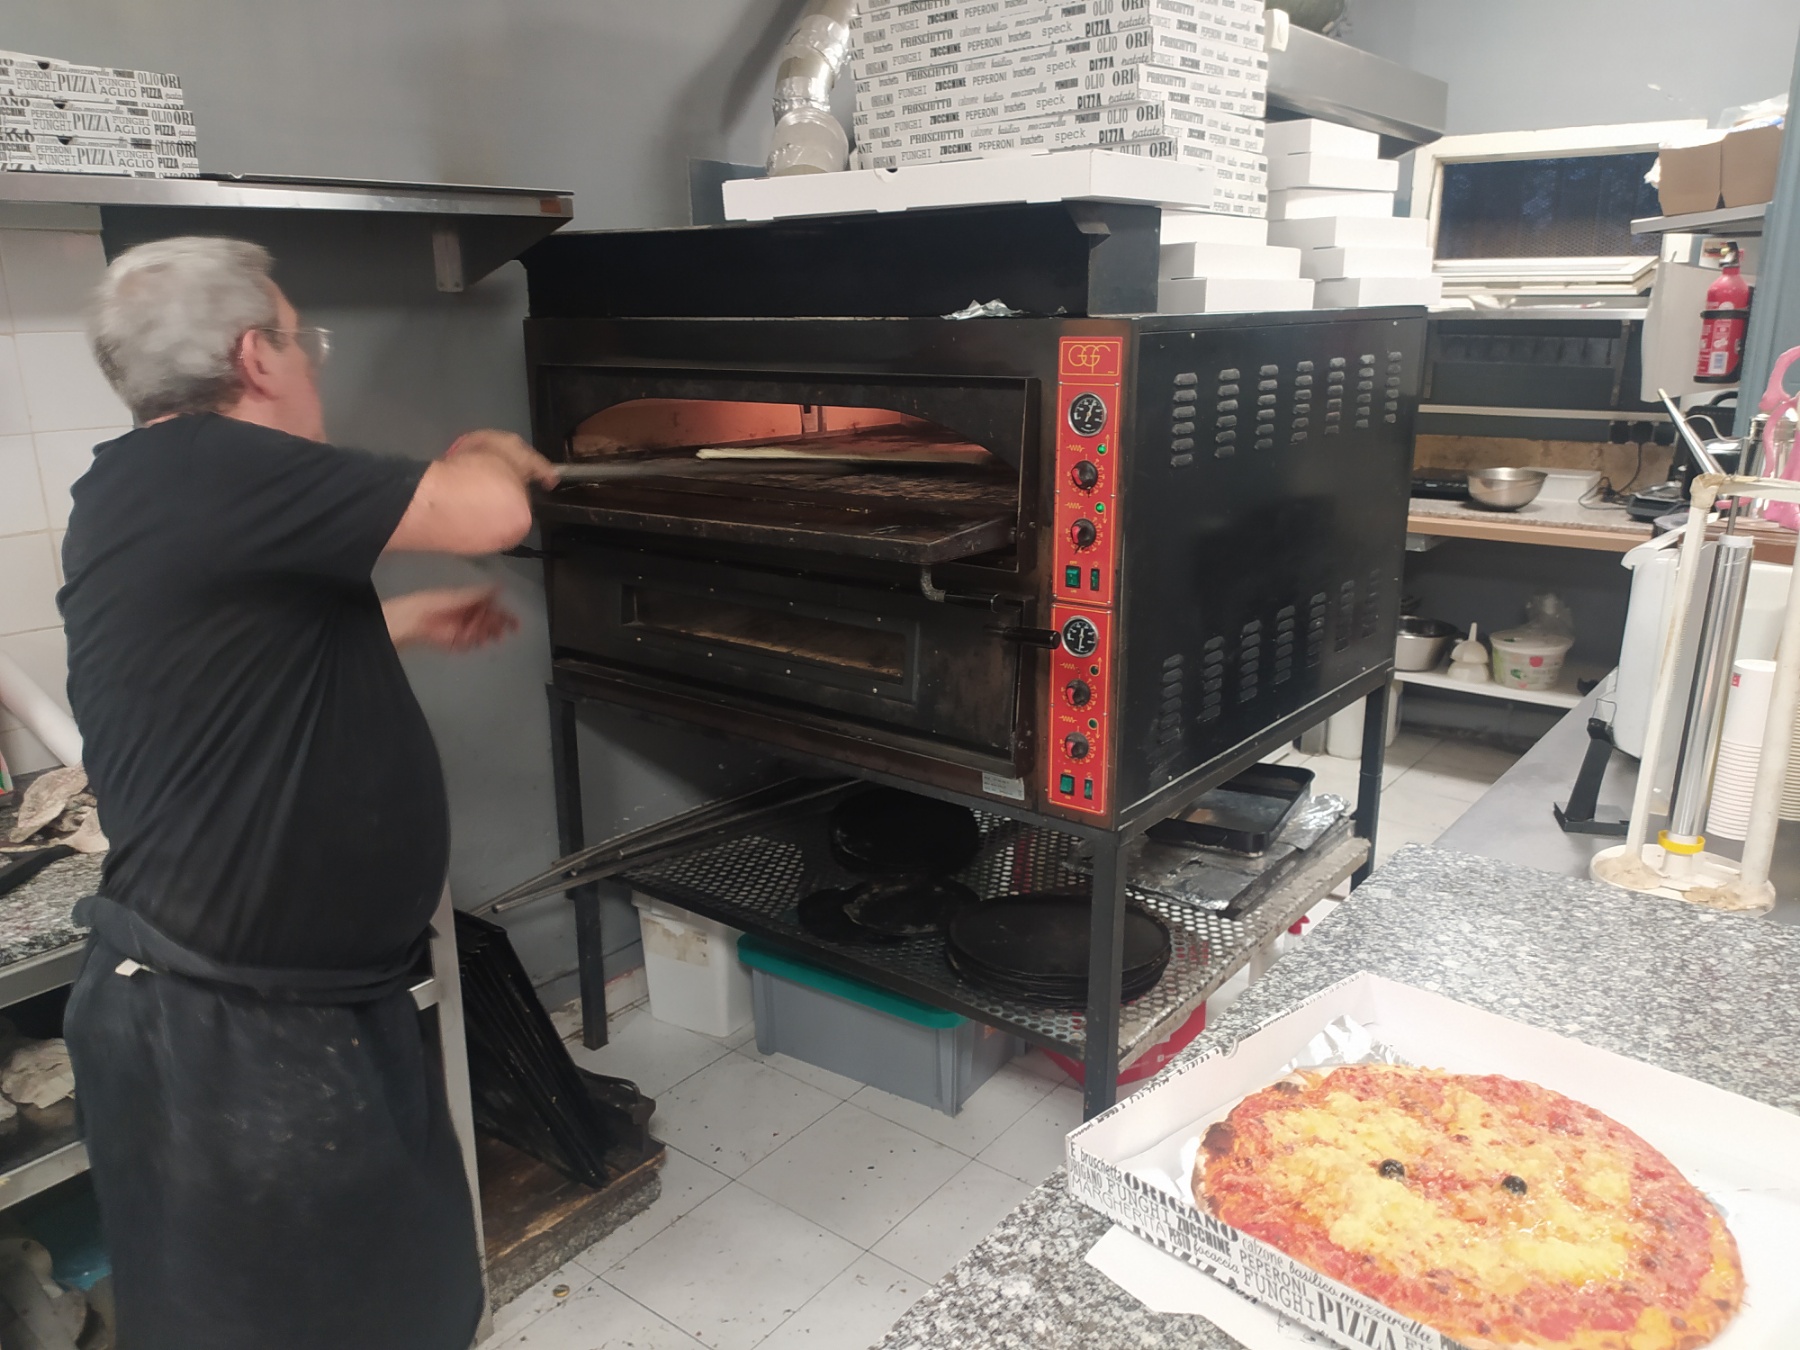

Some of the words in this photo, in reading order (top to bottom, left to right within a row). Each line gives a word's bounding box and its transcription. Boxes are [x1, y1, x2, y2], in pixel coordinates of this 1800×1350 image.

[964, 2, 999, 18] PEPERONI
[900, 29, 953, 48] PROSCIUTTO
[1093, 0, 1114, 16] OLIO
[967, 36, 1002, 51] PEPERONI
[1042, 21, 1072, 38] speck
[1085, 19, 1111, 37] PIZZA
[906, 63, 958, 82] PROSCIUTTO
[1097, 36, 1117, 53] OLIO
[973, 71, 1007, 86] PEPERONI
[1046, 58, 1076, 75] speck
[15, 69, 52, 79] PEPERONI
[57, 73, 97, 93] PIZZA
[98, 77, 137, 88] FUNGHI
[17, 78, 56, 92] FUNGHI
[100, 86, 137, 98] AGLIO
[140, 86, 163, 99] PIZZA
[138, 72, 160, 86] OLIO
[902, 98, 952, 115] PROSCIUTTO
[1085, 73, 1105, 90] OLIO
[965, 107, 999, 120] PEPERONI
[1036, 94, 1065, 110] speck
[1077, 93, 1101, 109] PIZZA
[31, 109, 67, 119] PEPERONI
[72, 113, 111, 132] PIZZA
[113, 116, 151, 126] FUNGHI
[33, 118, 72, 131] FUNGHI
[114, 125, 151, 135] AGLIO
[154, 124, 176, 136] PIZZA
[152, 110, 173, 123] OLIO
[910, 129, 964, 145] PROSCIUTTO
[1107, 108, 1128, 125] OLIO
[940, 142, 972, 155] ZUCCHINE
[979, 139, 1014, 150] PEPERONI
[1054, 128, 1086, 143] speck
[1099, 127, 1125, 143] PIZZA
[36, 144, 72, 154] PEPERONI
[77, 148, 115, 166] PIZZA
[38, 154, 77, 166] FUNGHI
[119, 158, 154, 168] AGLIO
[158, 157, 179, 169] PIZZA
[1072, 1174, 1168, 1239] MARGHERITA
[1243, 1265, 1317, 1322] FUNGHI
[1080, 1147, 1122, 1182] bruschetta
[1124, 1172, 1238, 1242] ORIGANO
[1242, 1237, 1284, 1268] calzone
[1340, 1292, 1433, 1343] mozzarella
[1106, 1177, 1173, 1226] FUNGHI
[1176, 1215, 1232, 1259] ZUCCHINE
[1240, 1249, 1306, 1297] PEPERONI
